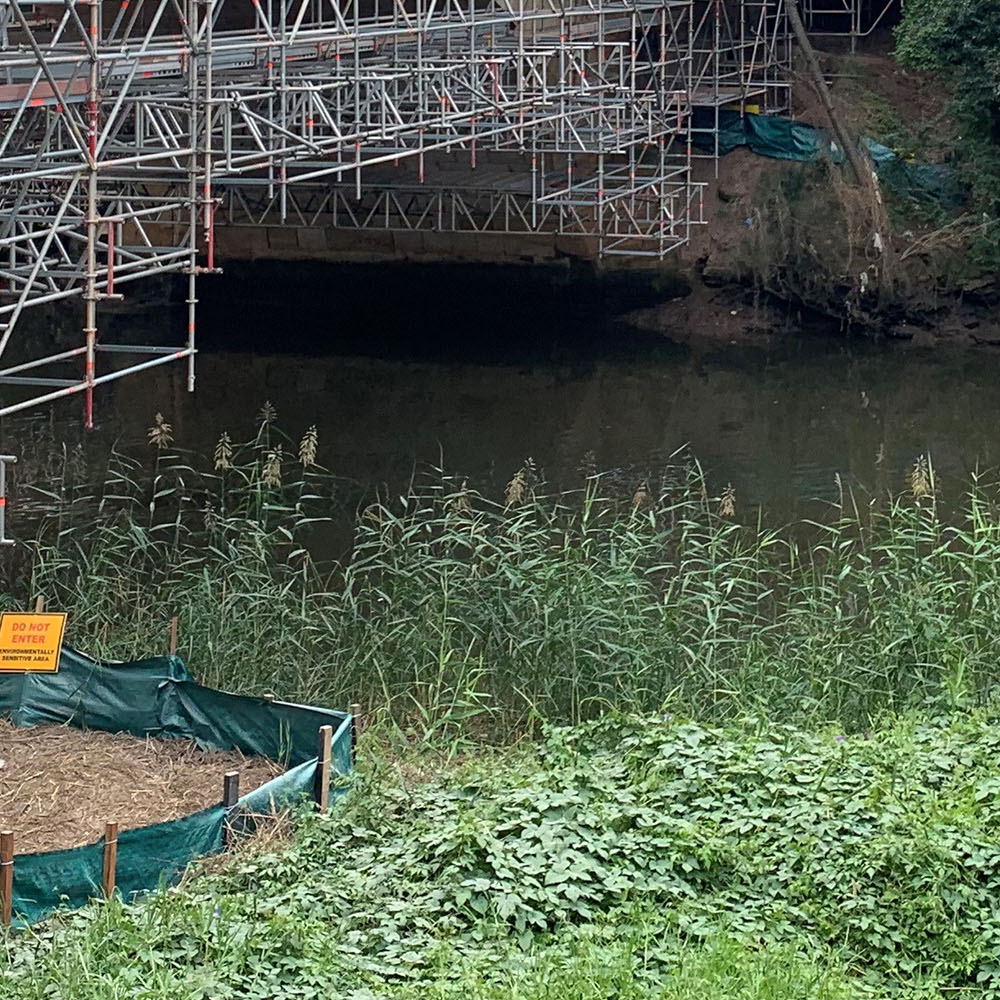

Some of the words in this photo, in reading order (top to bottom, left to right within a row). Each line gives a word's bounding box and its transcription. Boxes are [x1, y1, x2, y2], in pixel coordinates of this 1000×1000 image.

[12, 623, 26, 631] DO
[29, 623, 50, 631] NOT
[12, 634, 45, 643] ENTER
